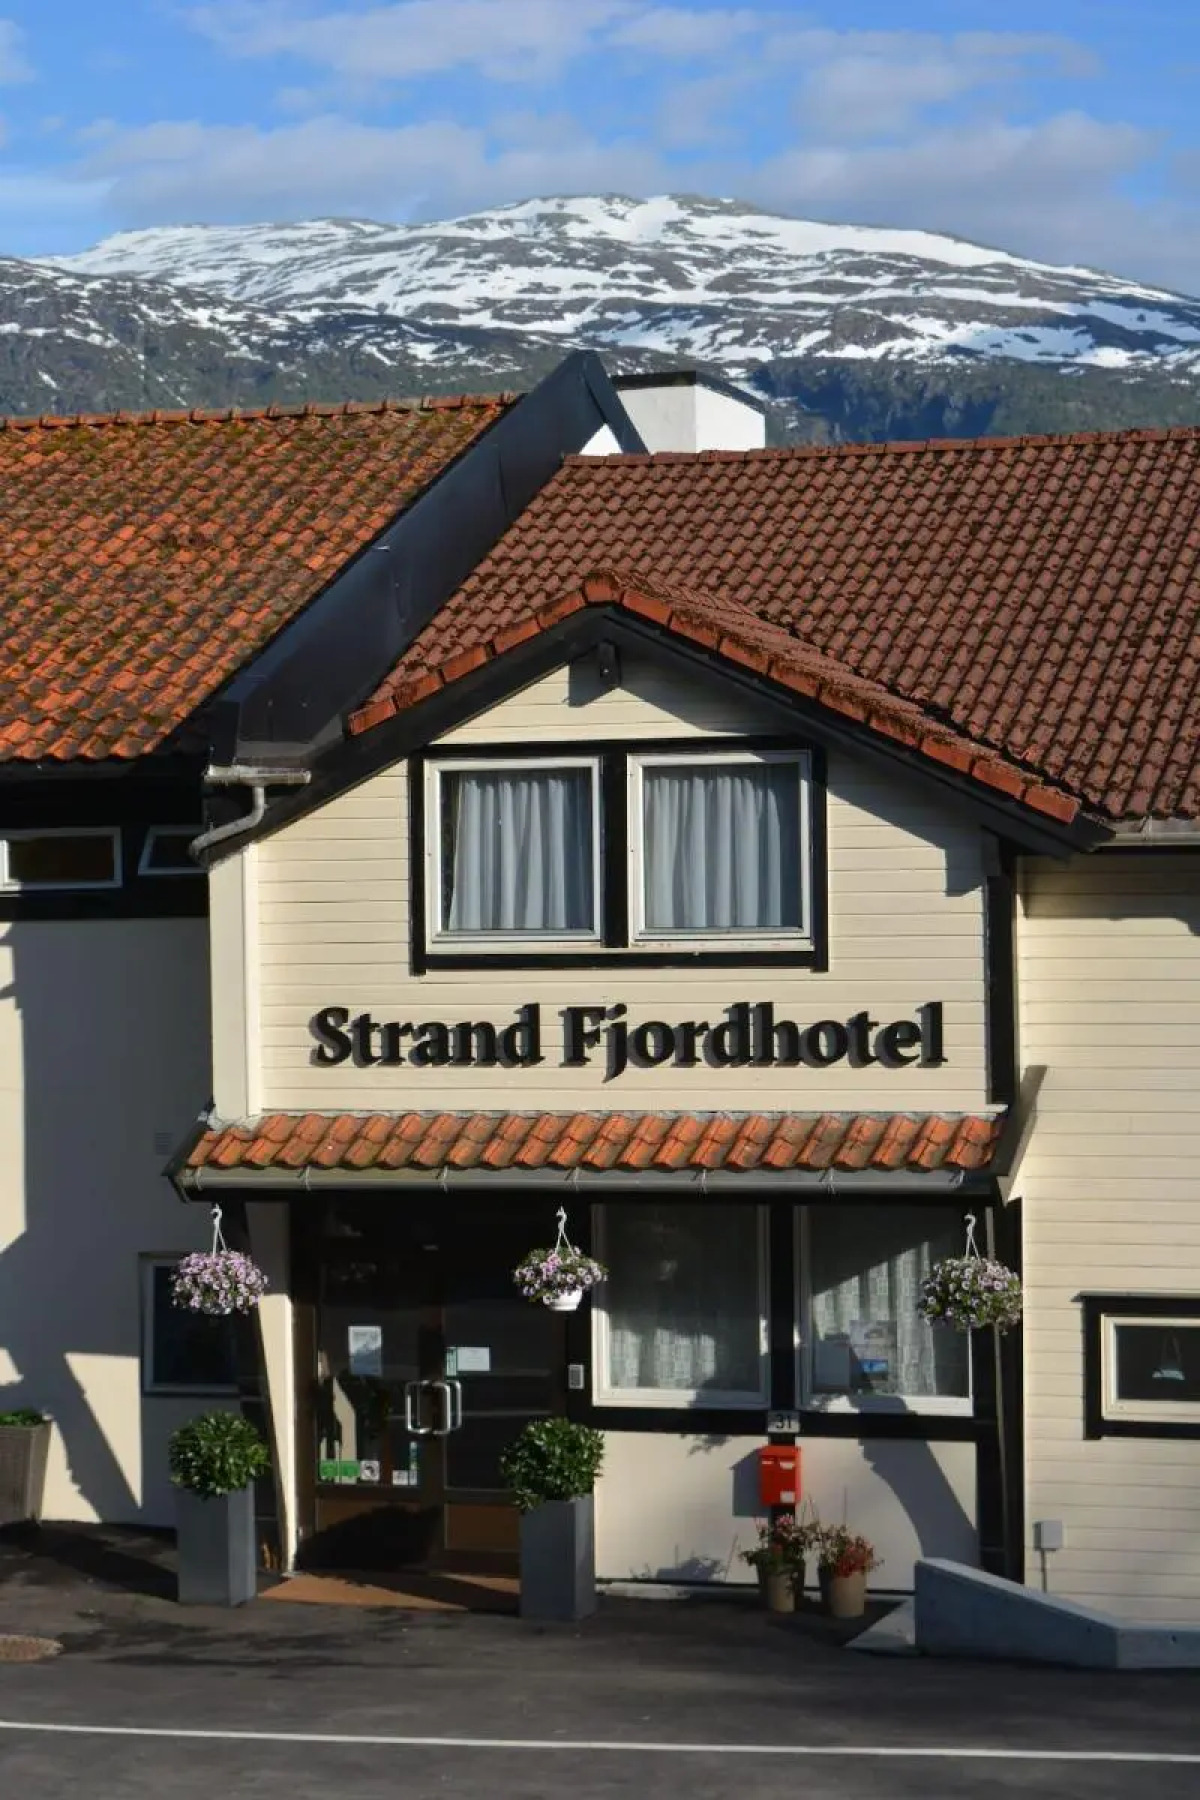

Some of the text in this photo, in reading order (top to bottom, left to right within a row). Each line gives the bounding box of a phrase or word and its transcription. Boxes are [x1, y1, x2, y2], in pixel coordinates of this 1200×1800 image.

[313, 1001, 948, 1083] Strand Fjordhotel
[775, 1414, 792, 1429] 31
